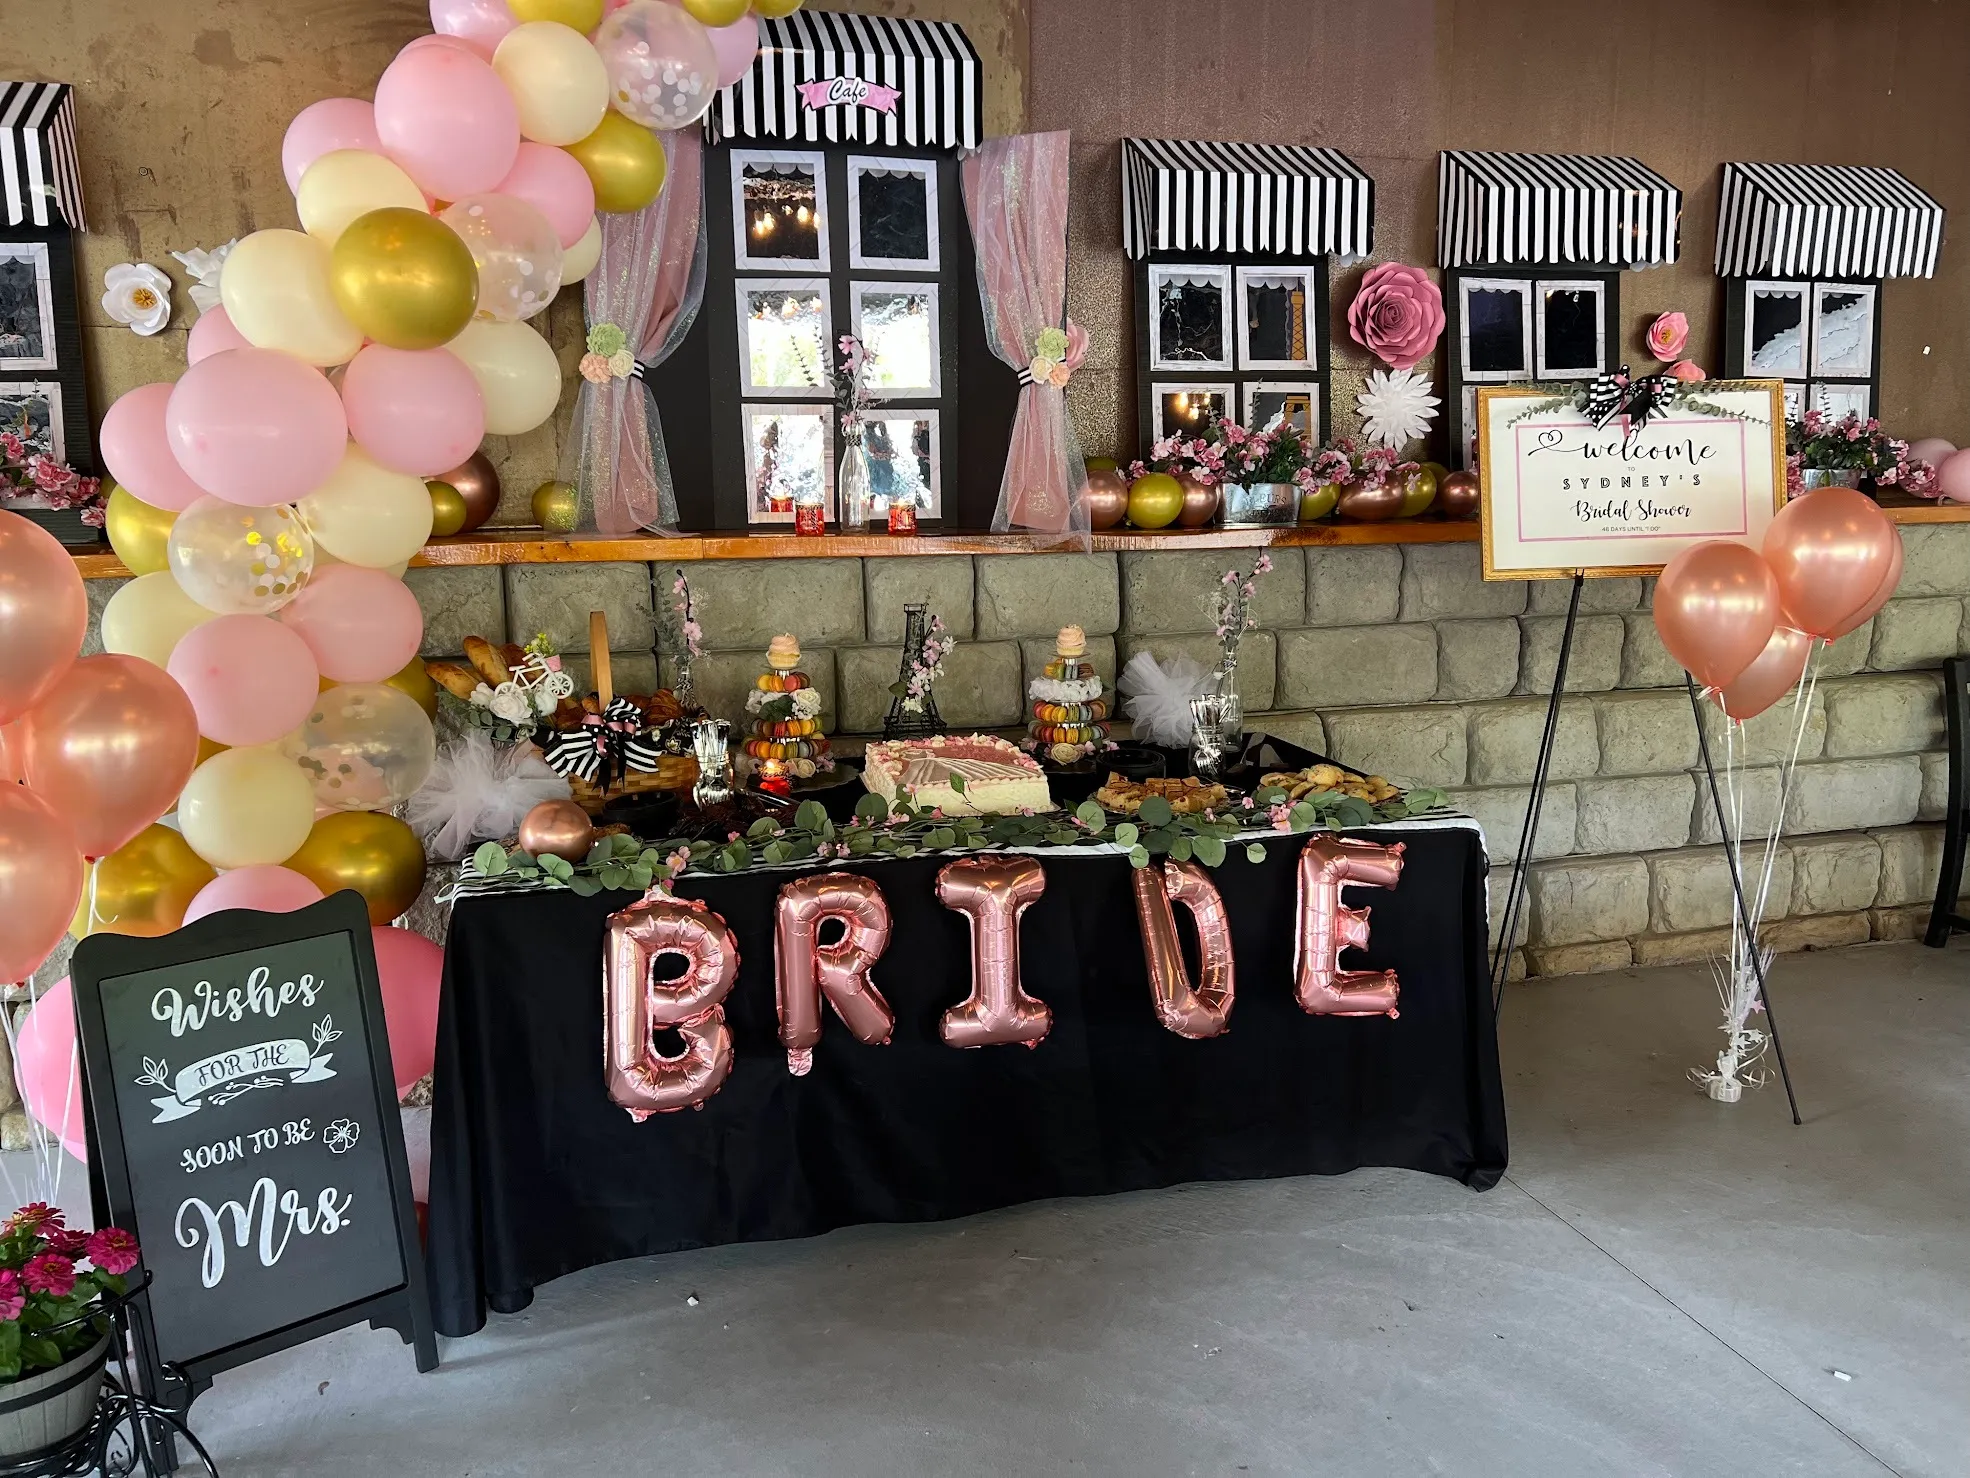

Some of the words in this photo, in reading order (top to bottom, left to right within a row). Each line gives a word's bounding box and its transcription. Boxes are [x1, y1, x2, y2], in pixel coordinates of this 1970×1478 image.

[828, 79, 867, 103] Cafe
[1580, 428, 1716, 465] welcome
[1563, 474, 1701, 490] SYDNEY'S
[1570, 499, 1632, 521] Bridal
[1634, 499, 1692, 521] Shower
[603, 834, 1405, 1124] BRIDE
[151, 966, 324, 1037] Wishes
[194, 1053, 243, 1087] FOR
[246, 1043, 289, 1070] THE
[179, 1135, 244, 1173] SOON
[247, 1127, 279, 1154] TO
[281, 1117, 315, 1146] BE
[174, 1177, 353, 1289] Mrs.
